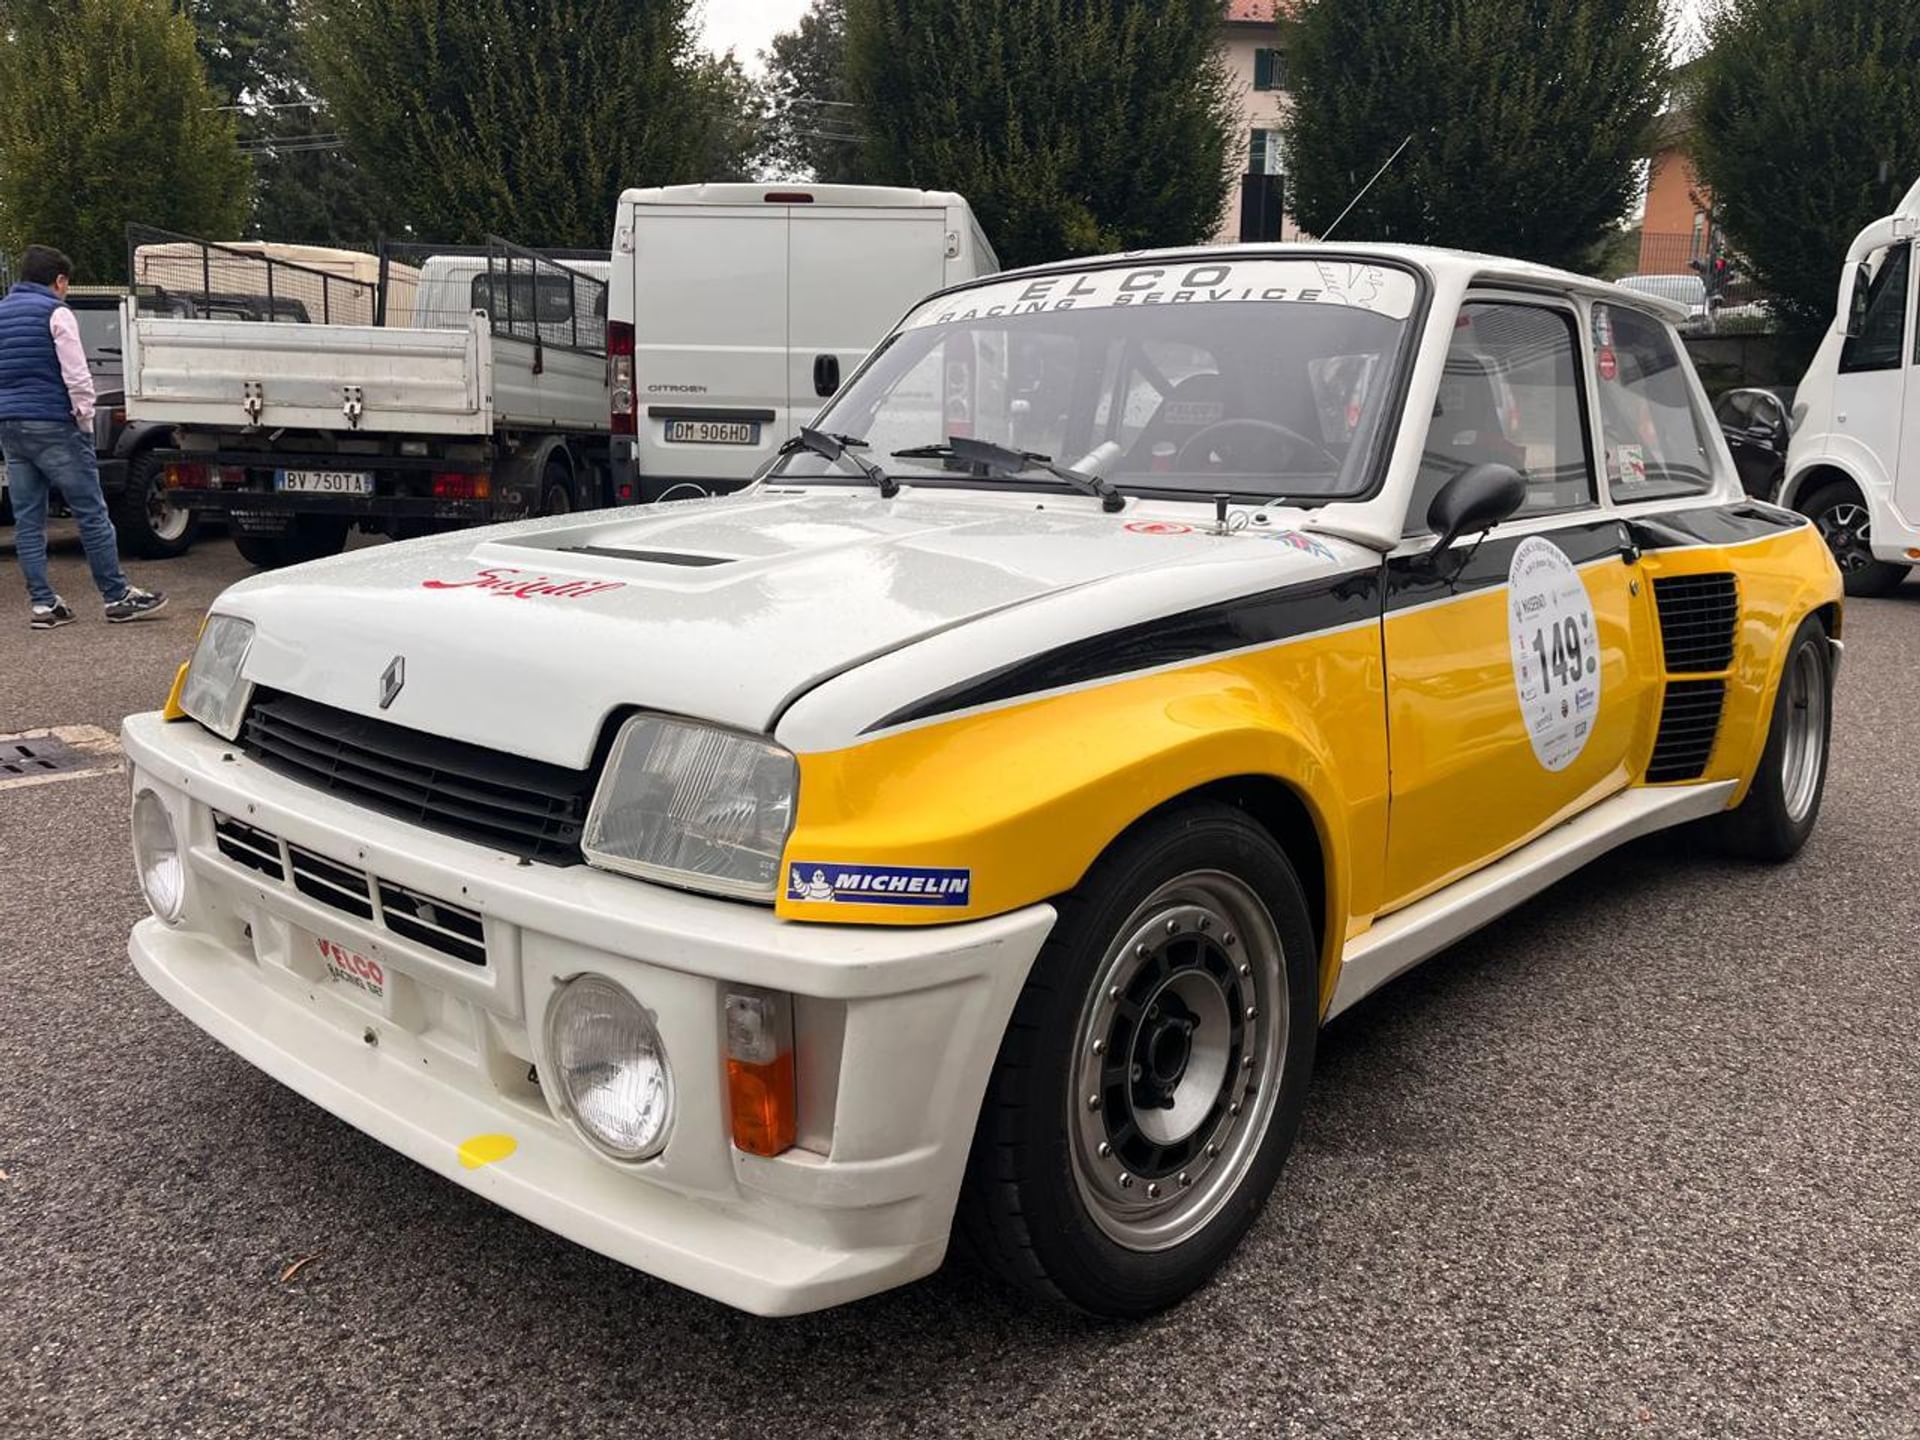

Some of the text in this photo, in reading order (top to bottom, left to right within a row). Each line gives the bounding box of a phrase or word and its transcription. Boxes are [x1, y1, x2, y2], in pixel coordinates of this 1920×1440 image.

[1019, 265, 1232, 301] ELCO
[937, 287, 1323, 324] RACING SERVICE
[675, 422, 749, 442] DM 906HD
[287, 472, 362, 492] BV 750TA
[1532, 615, 1583, 694] 149
[835, 873, 968, 893] MICHELIN
